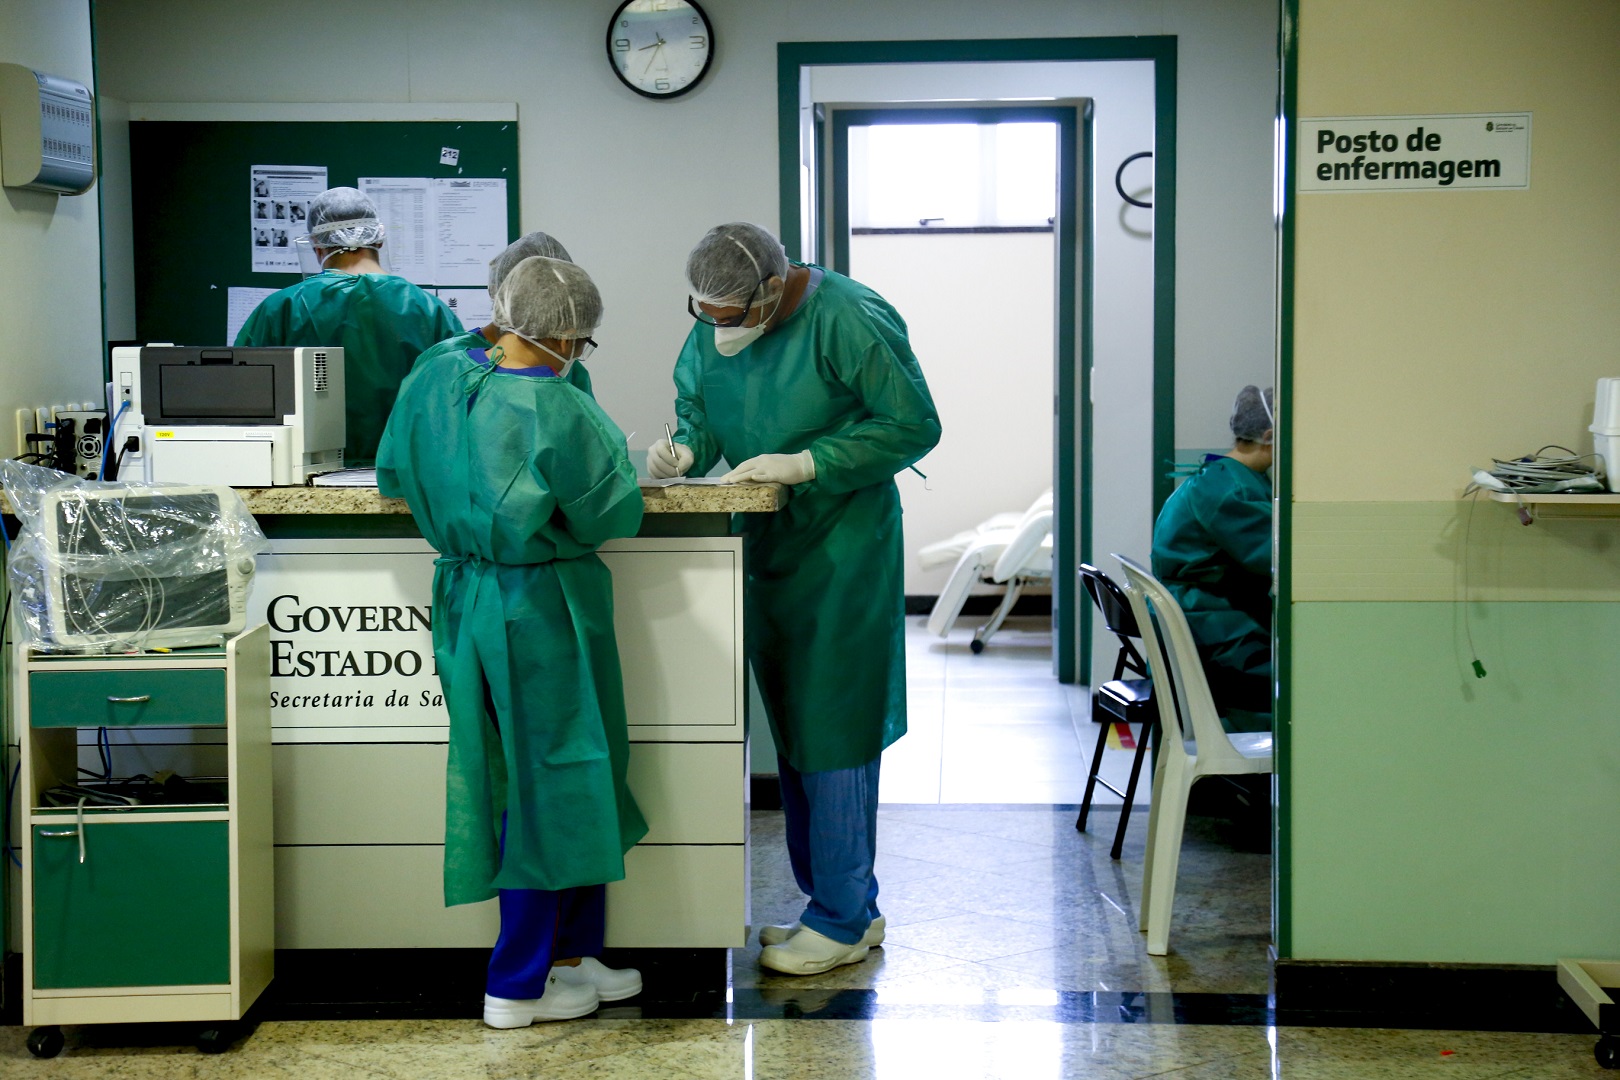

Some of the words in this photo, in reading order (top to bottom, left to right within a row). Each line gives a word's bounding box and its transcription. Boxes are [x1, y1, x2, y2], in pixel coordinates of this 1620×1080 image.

[615, 38, 631, 52] 9
[689, 35, 706, 50] 3
[655, 78, 670, 90] 6
[1317, 130, 1399, 153] Posto
[1406, 127, 1442, 152] de
[442, 149, 458, 159] 212
[1316, 155, 1501, 185] enfermagem
[270, 640, 423, 678] ESTADO
[270, 690, 374, 708] Secretaria
[385, 689, 409, 708] da
